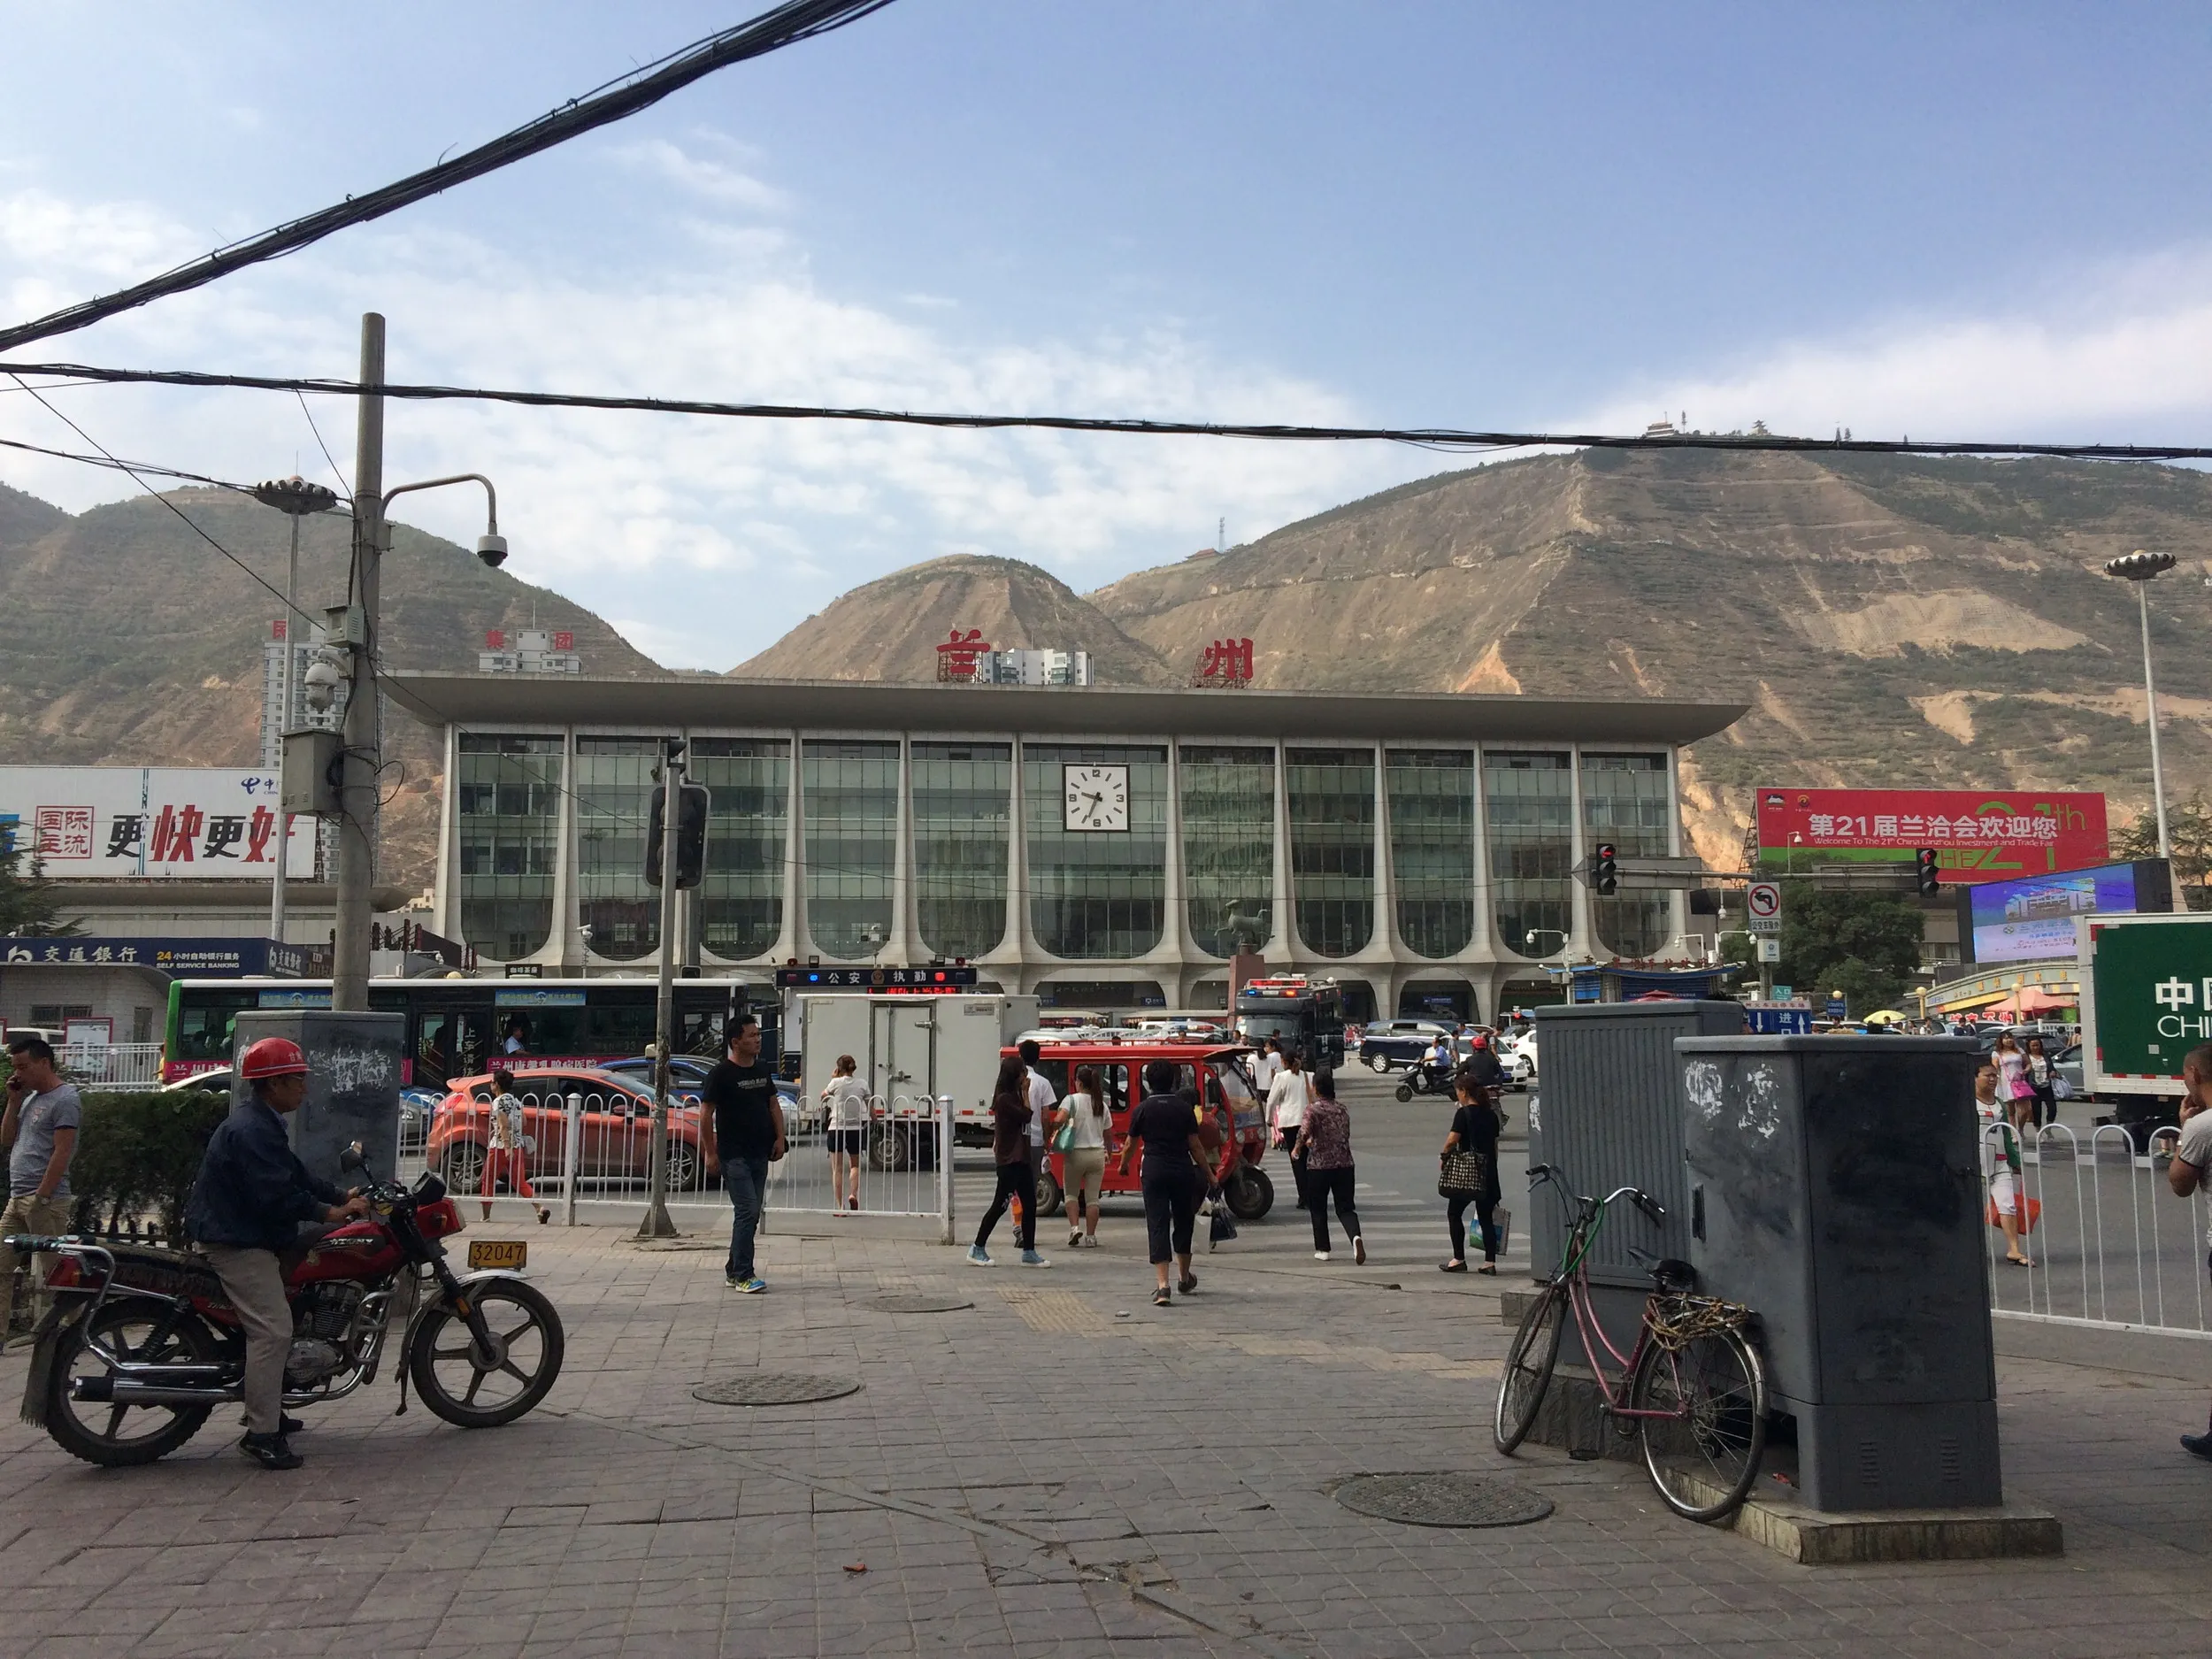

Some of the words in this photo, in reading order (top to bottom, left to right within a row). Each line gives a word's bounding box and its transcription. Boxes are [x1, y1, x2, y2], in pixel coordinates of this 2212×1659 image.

[936, 629, 991, 674] 兰
[1204, 638, 1253, 680] 州
[41, 810, 88, 831] 国际
[1093, 818, 1102, 827] 6
[1808, 814, 2058, 840] 第21届兰洽会欢迎您
[37, 833, 88, 854] 主流
[105, 804, 296, 862] 更快更好
[44, 945, 137, 963] 交通銀行
[828, 972, 861, 984] 公安
[893, 971, 926, 982] 执勤
[2155, 977, 2212, 1011] 中
[2157, 1015, 2212, 1038] CHI
[473, 1244, 525, 1261] 32047
